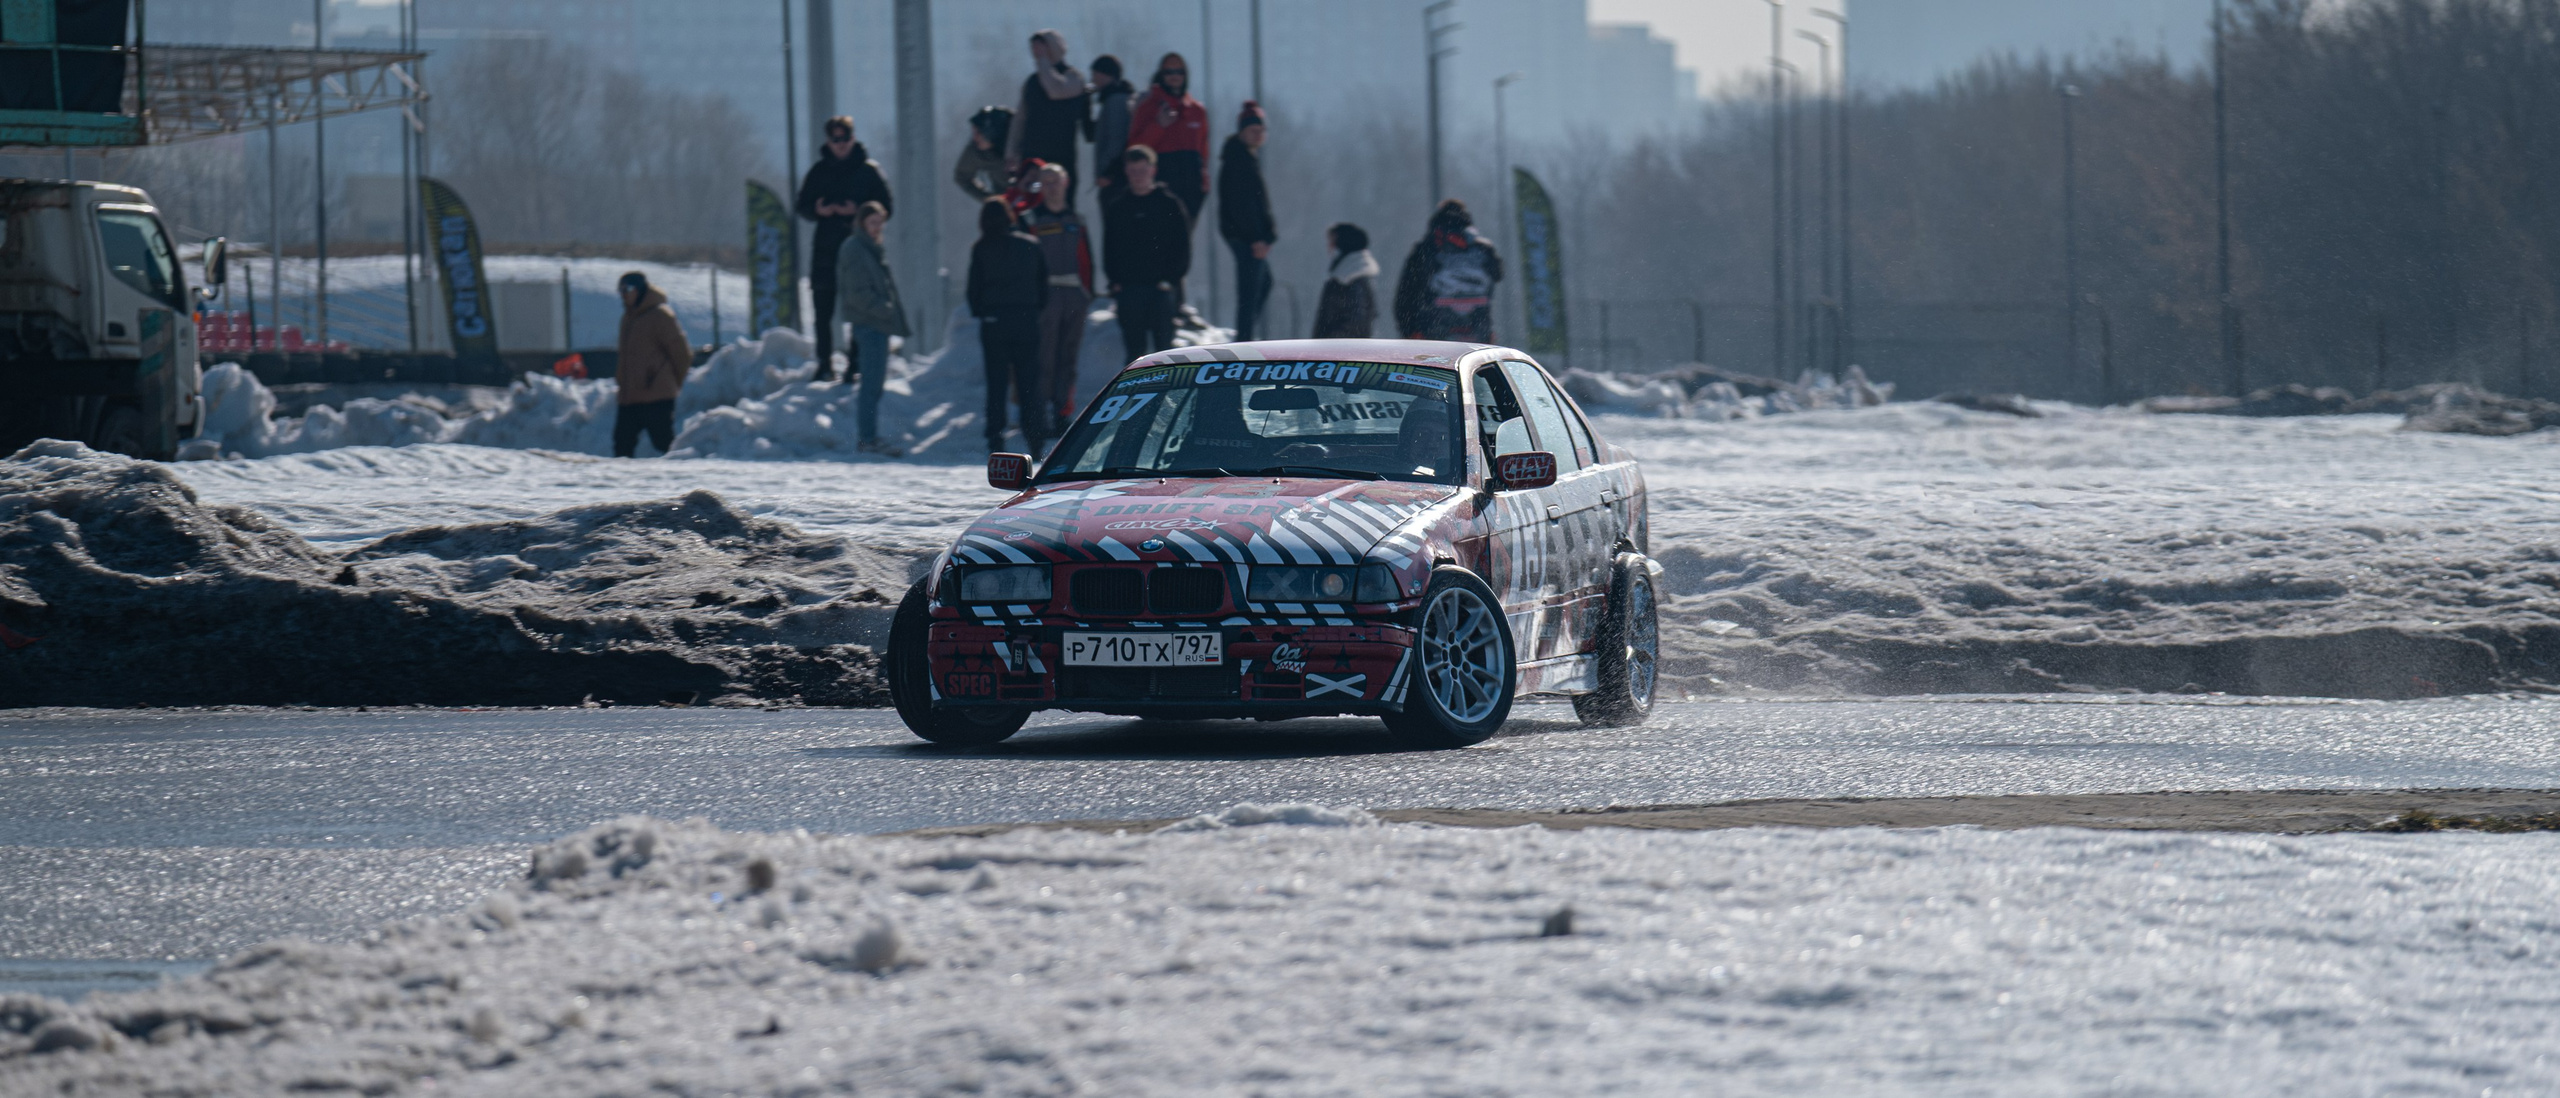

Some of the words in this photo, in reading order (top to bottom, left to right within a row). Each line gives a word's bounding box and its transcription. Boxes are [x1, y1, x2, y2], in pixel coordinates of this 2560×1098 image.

[1089, 392, 1158, 425] 87
[1094, 502, 1214, 517] DRIFT
[1174, 634, 1213, 655] 797
[1185, 654, 1205, 662] RUS
[948, 674, 991, 696] SPEC
